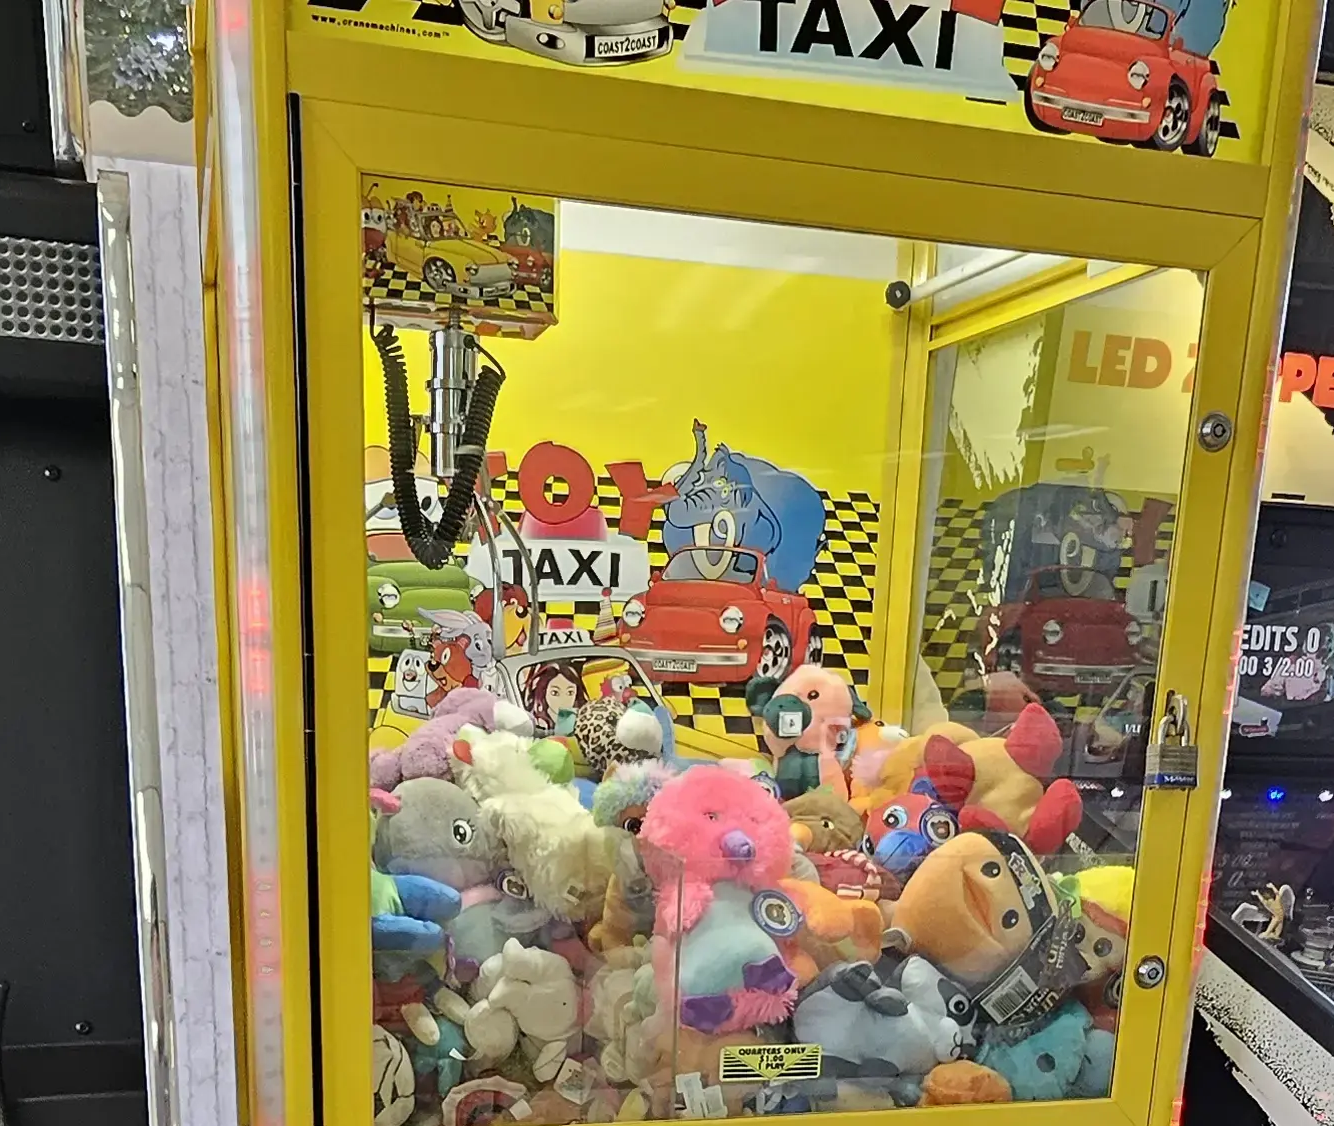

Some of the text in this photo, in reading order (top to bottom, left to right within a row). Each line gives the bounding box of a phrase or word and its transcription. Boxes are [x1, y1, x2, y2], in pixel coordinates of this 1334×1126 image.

[597, 33, 657, 56] COAST2COAST
[757, 0, 957, 70] TAXI
[1067, 331, 1171, 389] LED
[503, 549, 621, 588] TAXI
[538, 629, 583, 646] TAXI
[1241, 625, 1320, 653] EDITS 0
[1263, 657, 1314, 677] 3/2.00
[738, 1047, 807, 1056] QUARTERS ONLY
